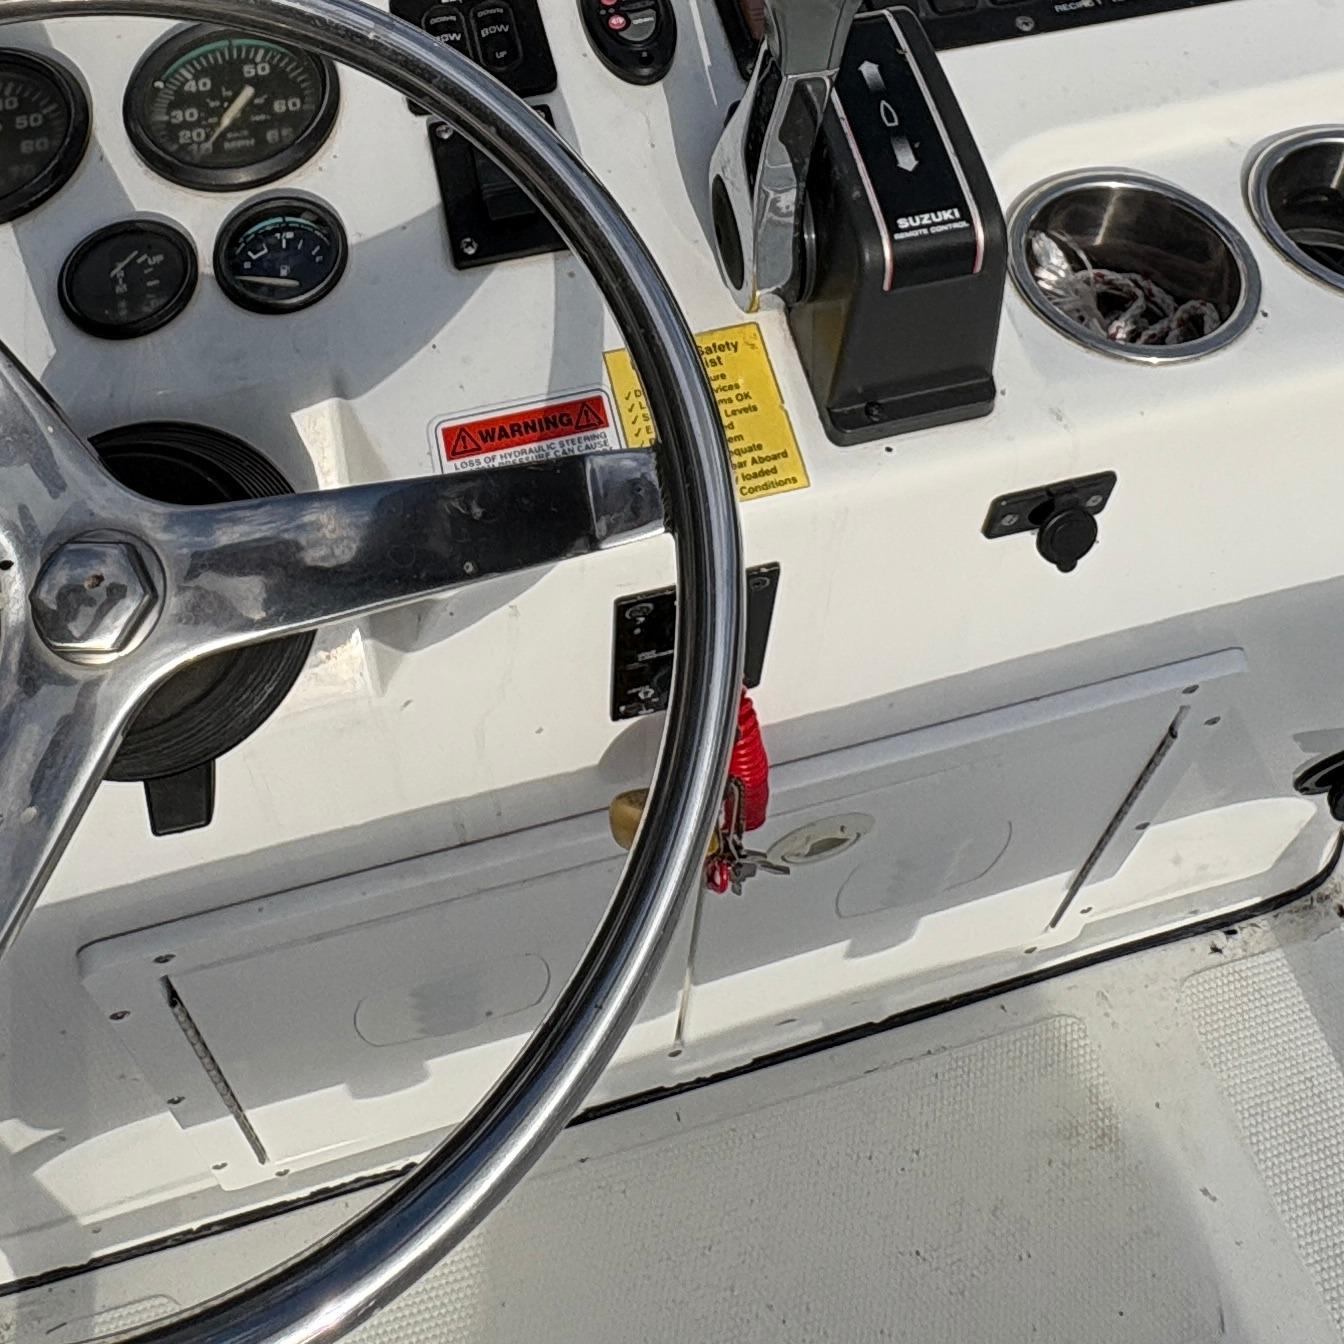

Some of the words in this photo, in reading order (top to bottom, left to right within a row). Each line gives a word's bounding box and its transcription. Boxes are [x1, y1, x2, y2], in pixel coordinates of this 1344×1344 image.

[480, 23, 510, 38] BOW
[494, 50, 509, 60] UP
[242, 62, 270, 78] 50
[183, 77, 212, 93] 40
[273, 97, 302, 113] 60
[14, 113, 44, 130] 50
[169, 108, 199, 124] 30
[177, 127, 206, 145] 20
[18, 137, 50, 155] 60
[896, 207, 961, 230] SUZUKI
[893, 227, 929, 241] REMOTE
[929, 219, 971, 234] CONTROL
[696, 340, 739, 356] Safety
[703, 355, 724, 369] ist
[714, 382, 741, 394] vices
[735, 391, 753, 403] OK
[724, 403, 759, 418] Levels
[477, 412, 575, 444] WARNING
[453, 458, 482, 471] LOSS
[483, 454, 497, 465] OF
[500, 442, 556, 461] HYDRAULIC
[558, 431, 608, 448] STEERING
[578, 439, 610, 453] CAUSE
[750, 449, 789, 466] Aboard
[741, 466, 778, 482] loaded
[739, 476, 798, 496] Conditions
